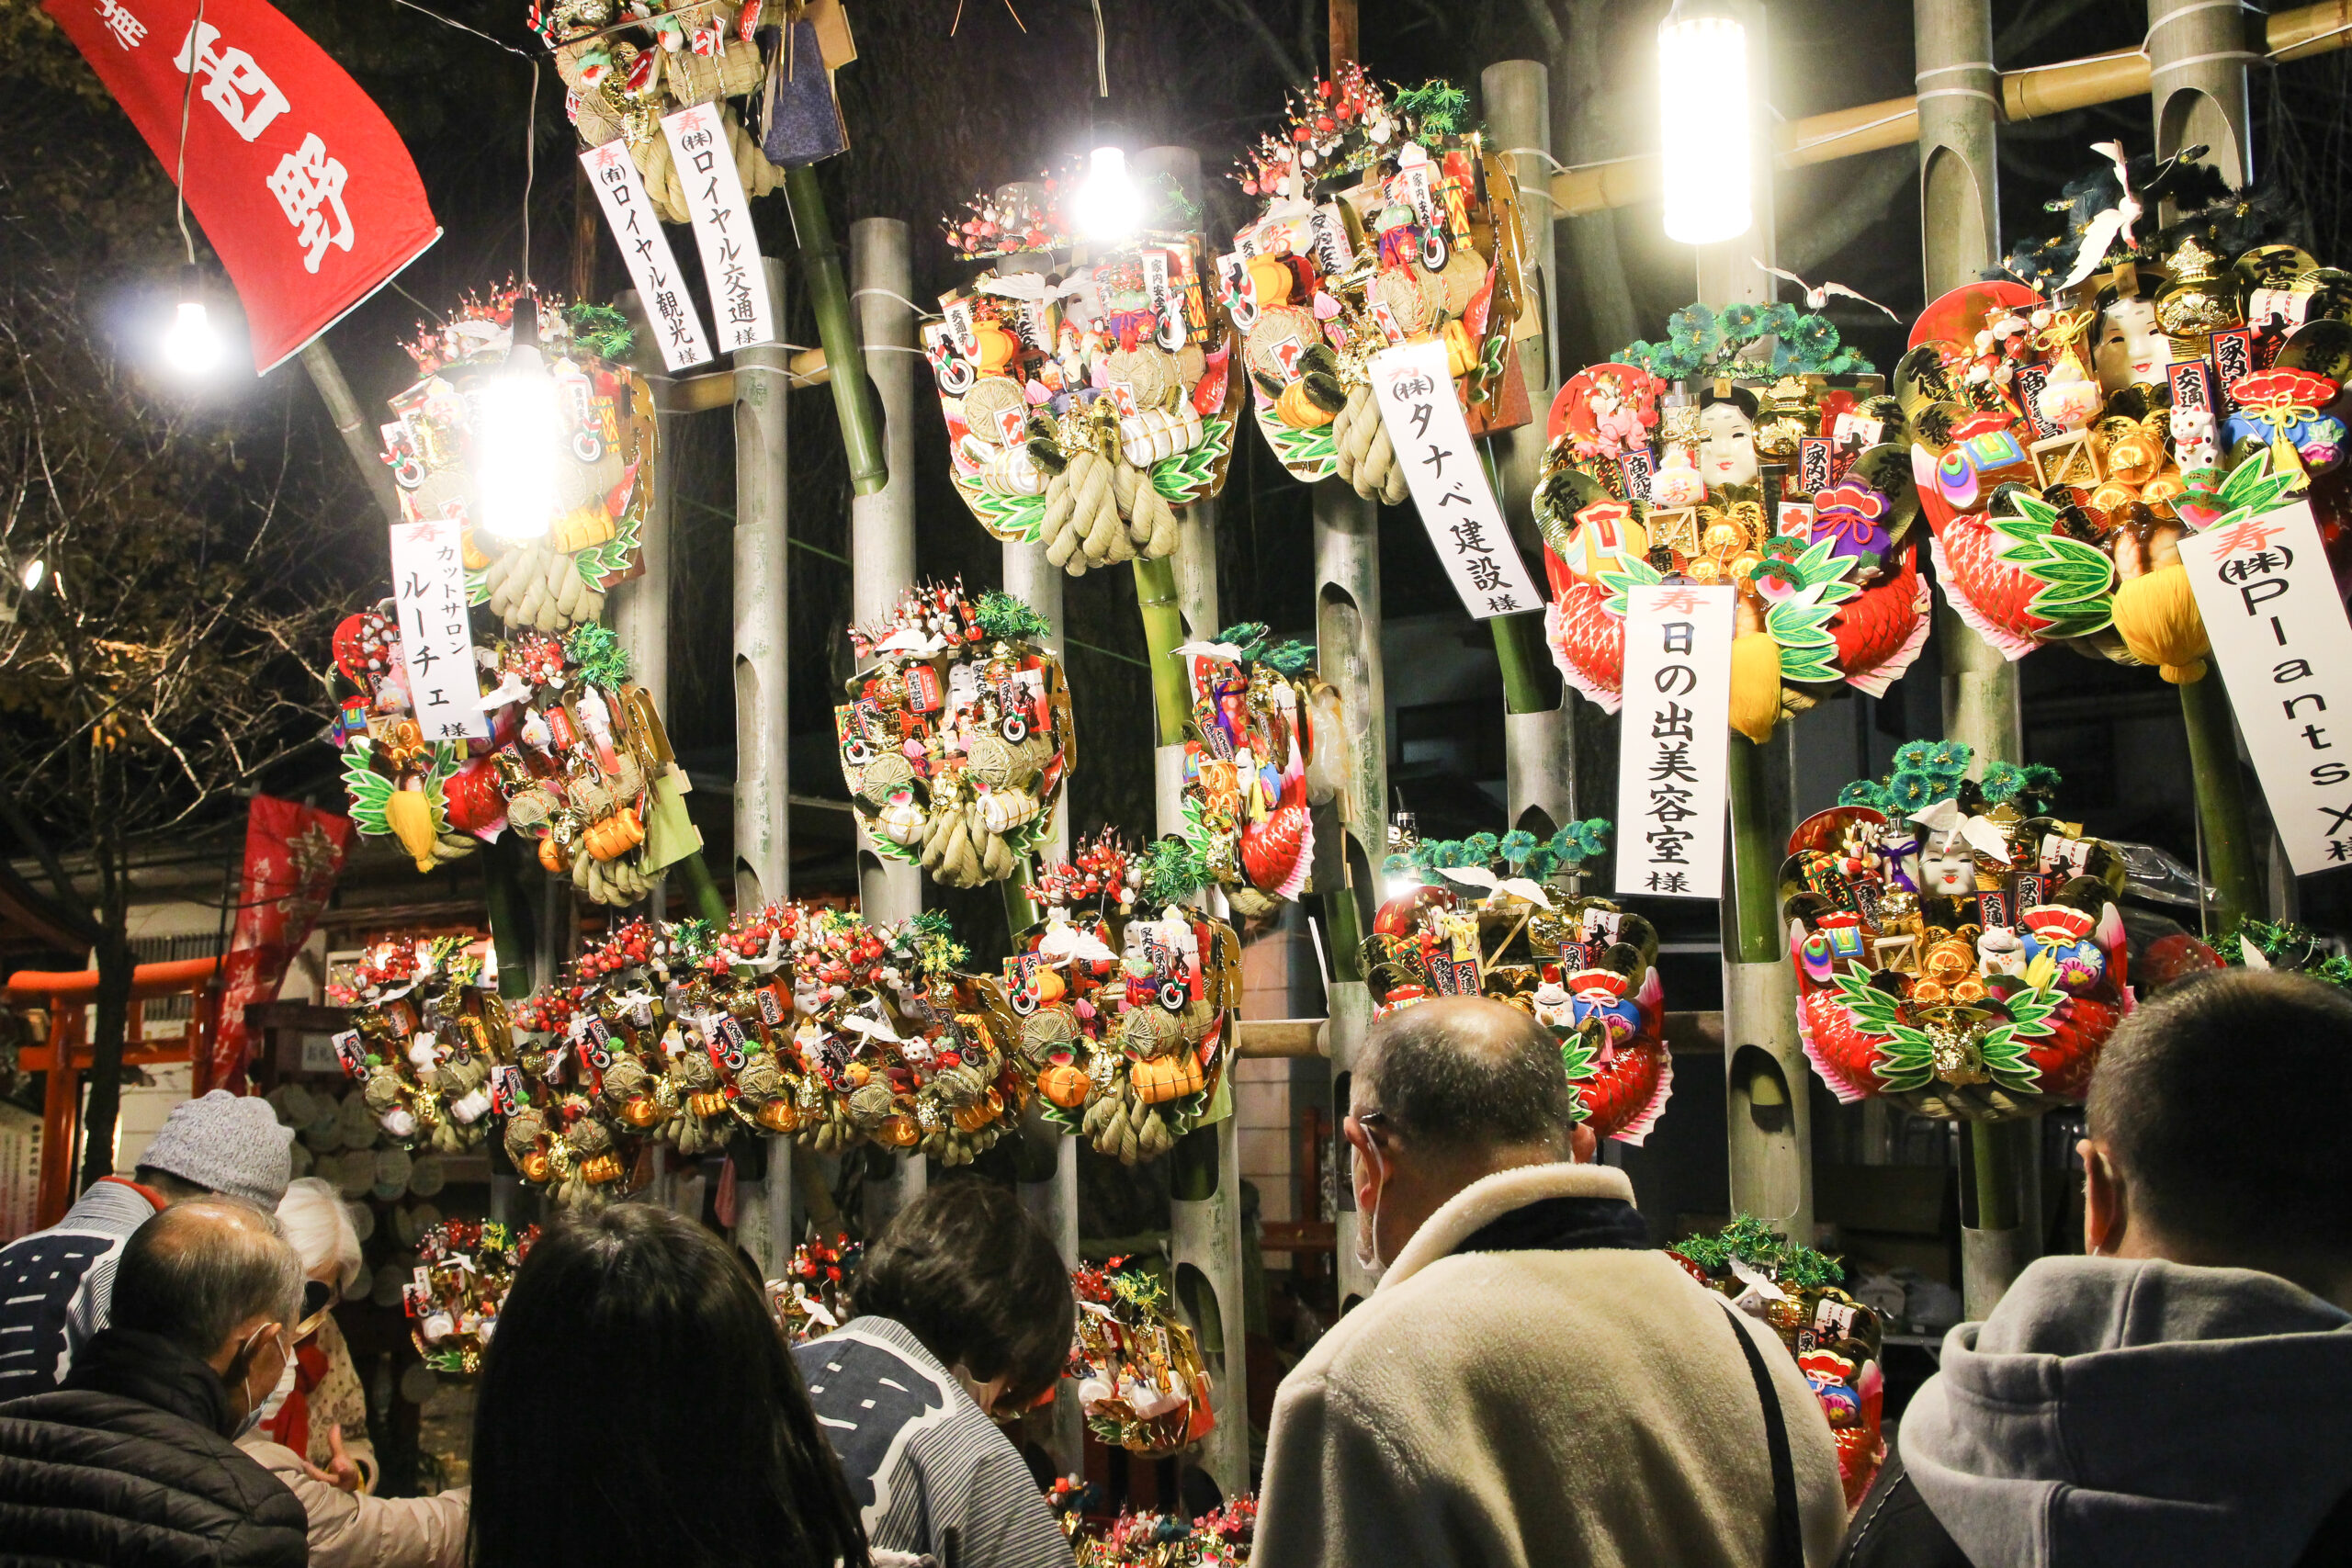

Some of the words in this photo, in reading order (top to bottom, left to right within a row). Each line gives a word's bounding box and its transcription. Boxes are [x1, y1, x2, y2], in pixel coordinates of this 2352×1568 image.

[1150, 258, 1166, 309] 家内安全
[1648, 587, 1711, 615] 寿
[1643, 621, 1700, 894] 日の出美容室様
